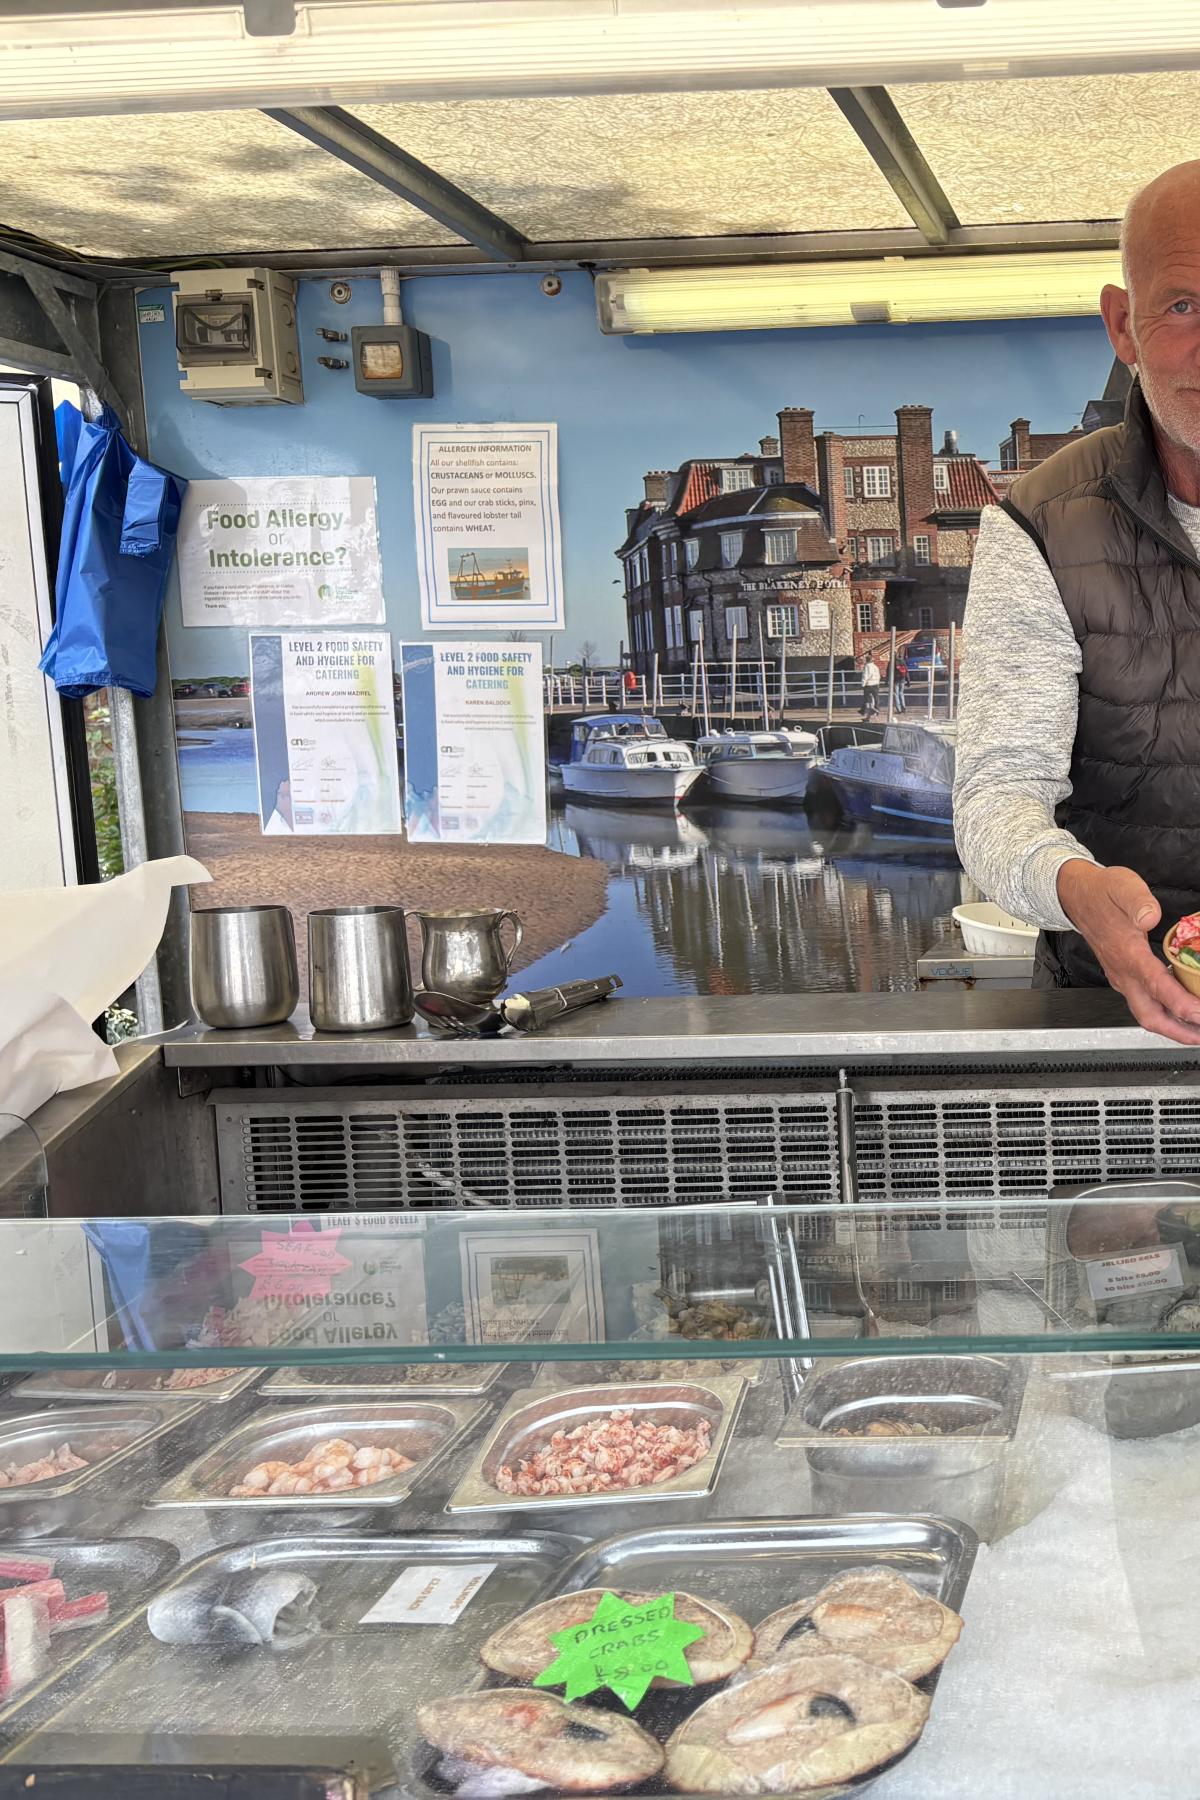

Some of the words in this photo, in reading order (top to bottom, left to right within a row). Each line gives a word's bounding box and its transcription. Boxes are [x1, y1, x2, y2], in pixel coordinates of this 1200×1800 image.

[438, 445, 476, 453] ALLERGEN
[495, 499, 517, 507] sticks,
[207, 510, 260, 529] Food
[265, 509, 344, 531] Allergy
[483, 511, 508, 519] lobster
[269, 533, 285, 545] or
[209, 547, 347, 568] Intolerance?
[741, 581, 757, 592] THE
[759, 580, 811, 590] BLAKENEY
[289, 641, 315, 652] LEVEL
[317, 642, 322, 652] 2
[326, 641, 349, 653] FOOD
[352, 641, 383, 652] SAFETY
[295, 655, 314, 666] AND
[317, 655, 354, 666] HYGIENE
[357, 655, 375, 666] FOR
[440, 652, 465, 662] LEVEL
[467, 652, 473, 662] 2
[476, 652, 499, 662] FOOD
[501, 652, 532, 663] SAFETY
[315, 669, 360, 680] CATERING
[447, 666, 465, 676] AND
[468, 666, 504, 676] HYGIENE
[507, 666, 524, 676] FOR
[466, 679, 508, 689] CATERING
[1102, 1258, 1136, 1267] JELLIED
[574, 1606, 671, 1644] DRESSED
[588, 1629, 661, 1660] CRABS
